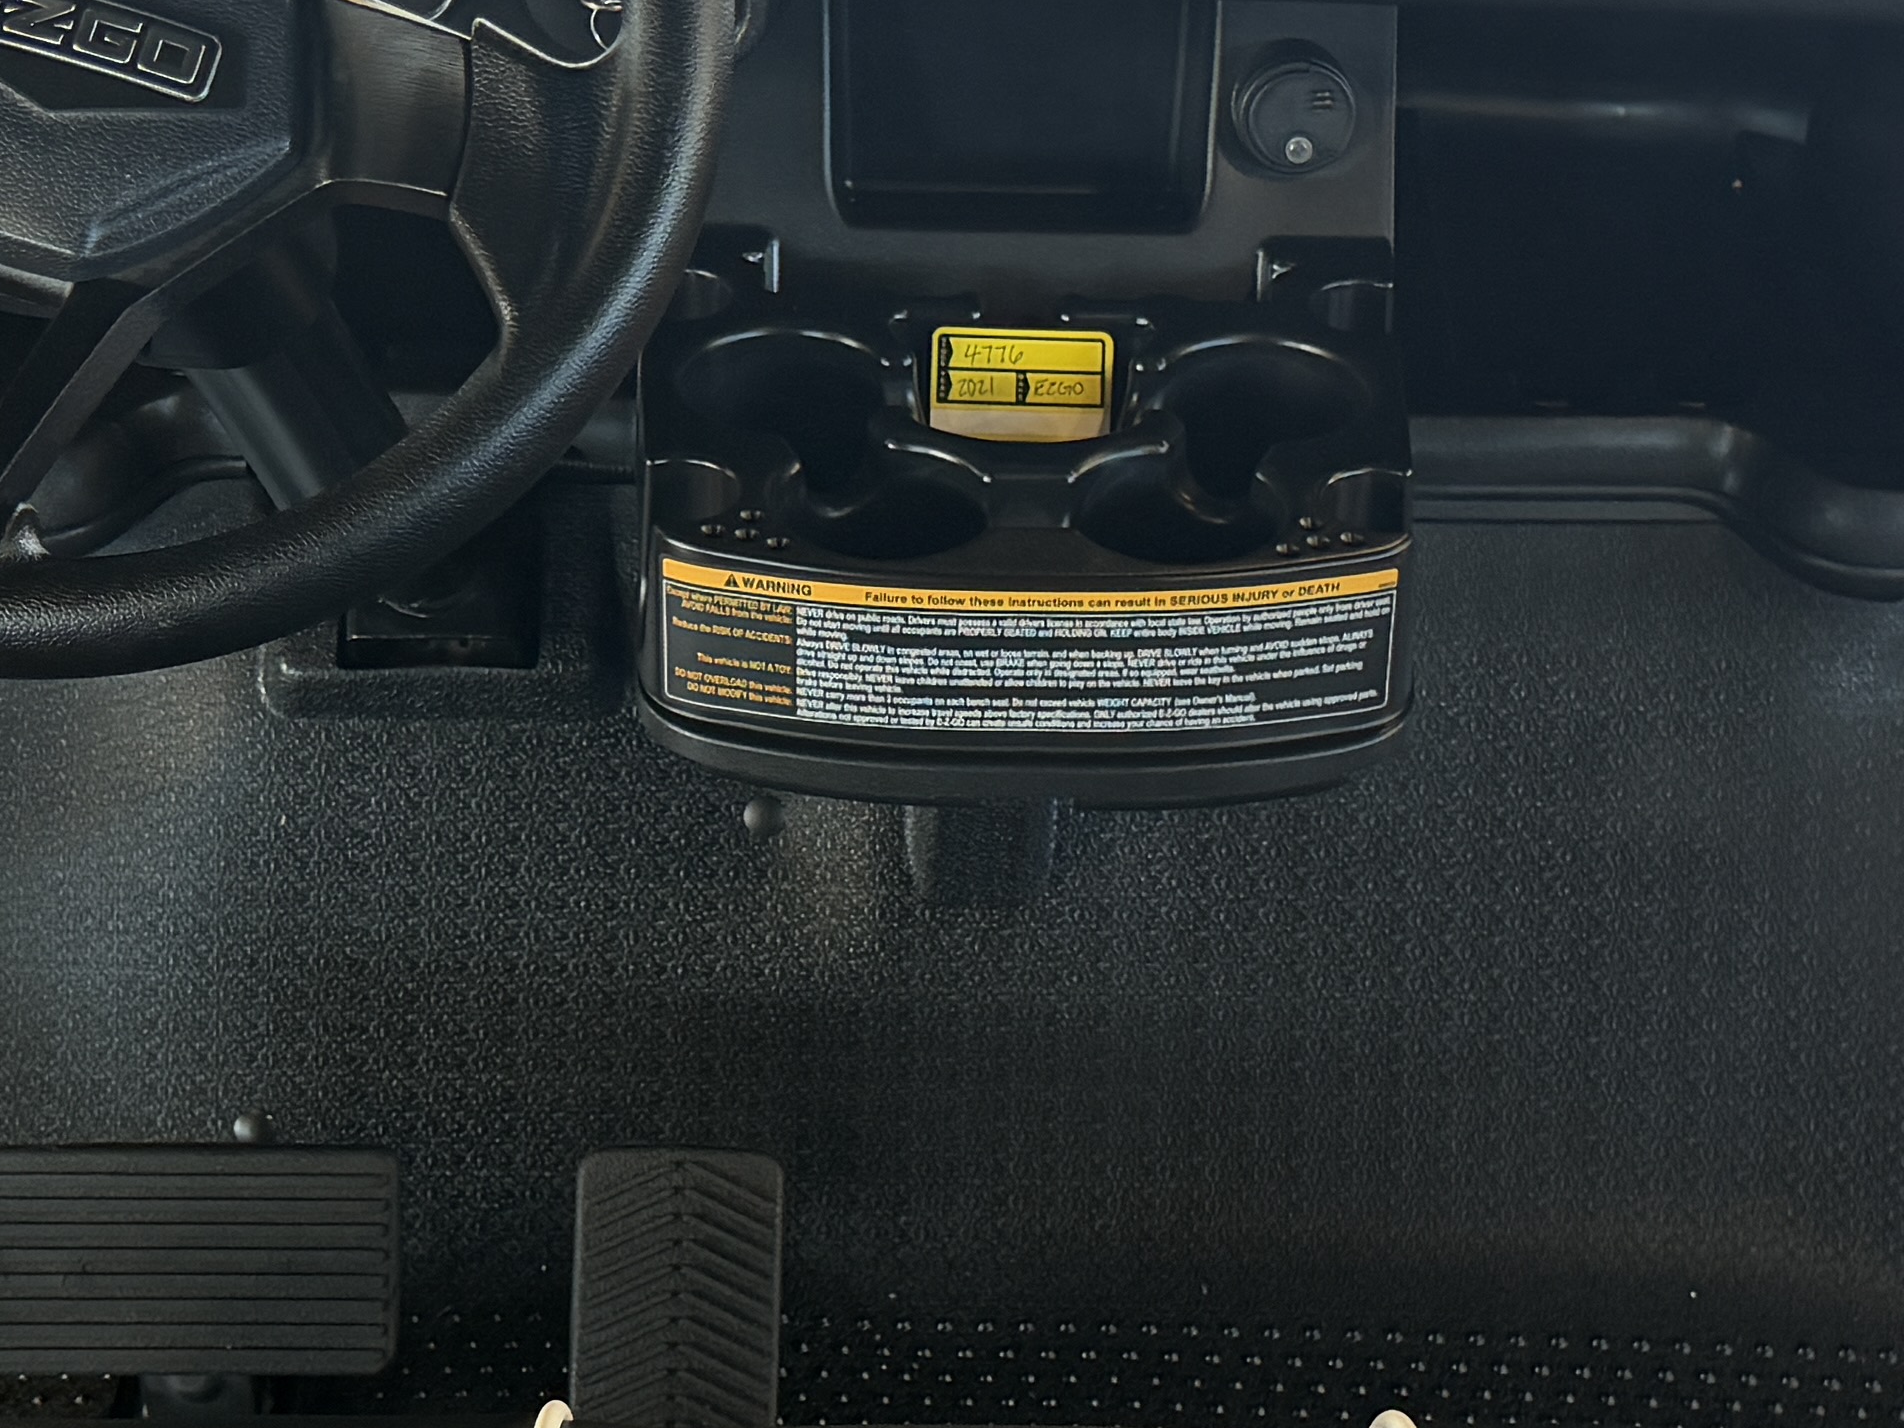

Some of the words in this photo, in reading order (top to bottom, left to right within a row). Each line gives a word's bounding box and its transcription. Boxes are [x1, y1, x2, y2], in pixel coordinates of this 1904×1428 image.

[964, 343, 1024, 366] 4776
[957, 376, 994, 398] 2021
[742, 576, 812, 597] WARNING
